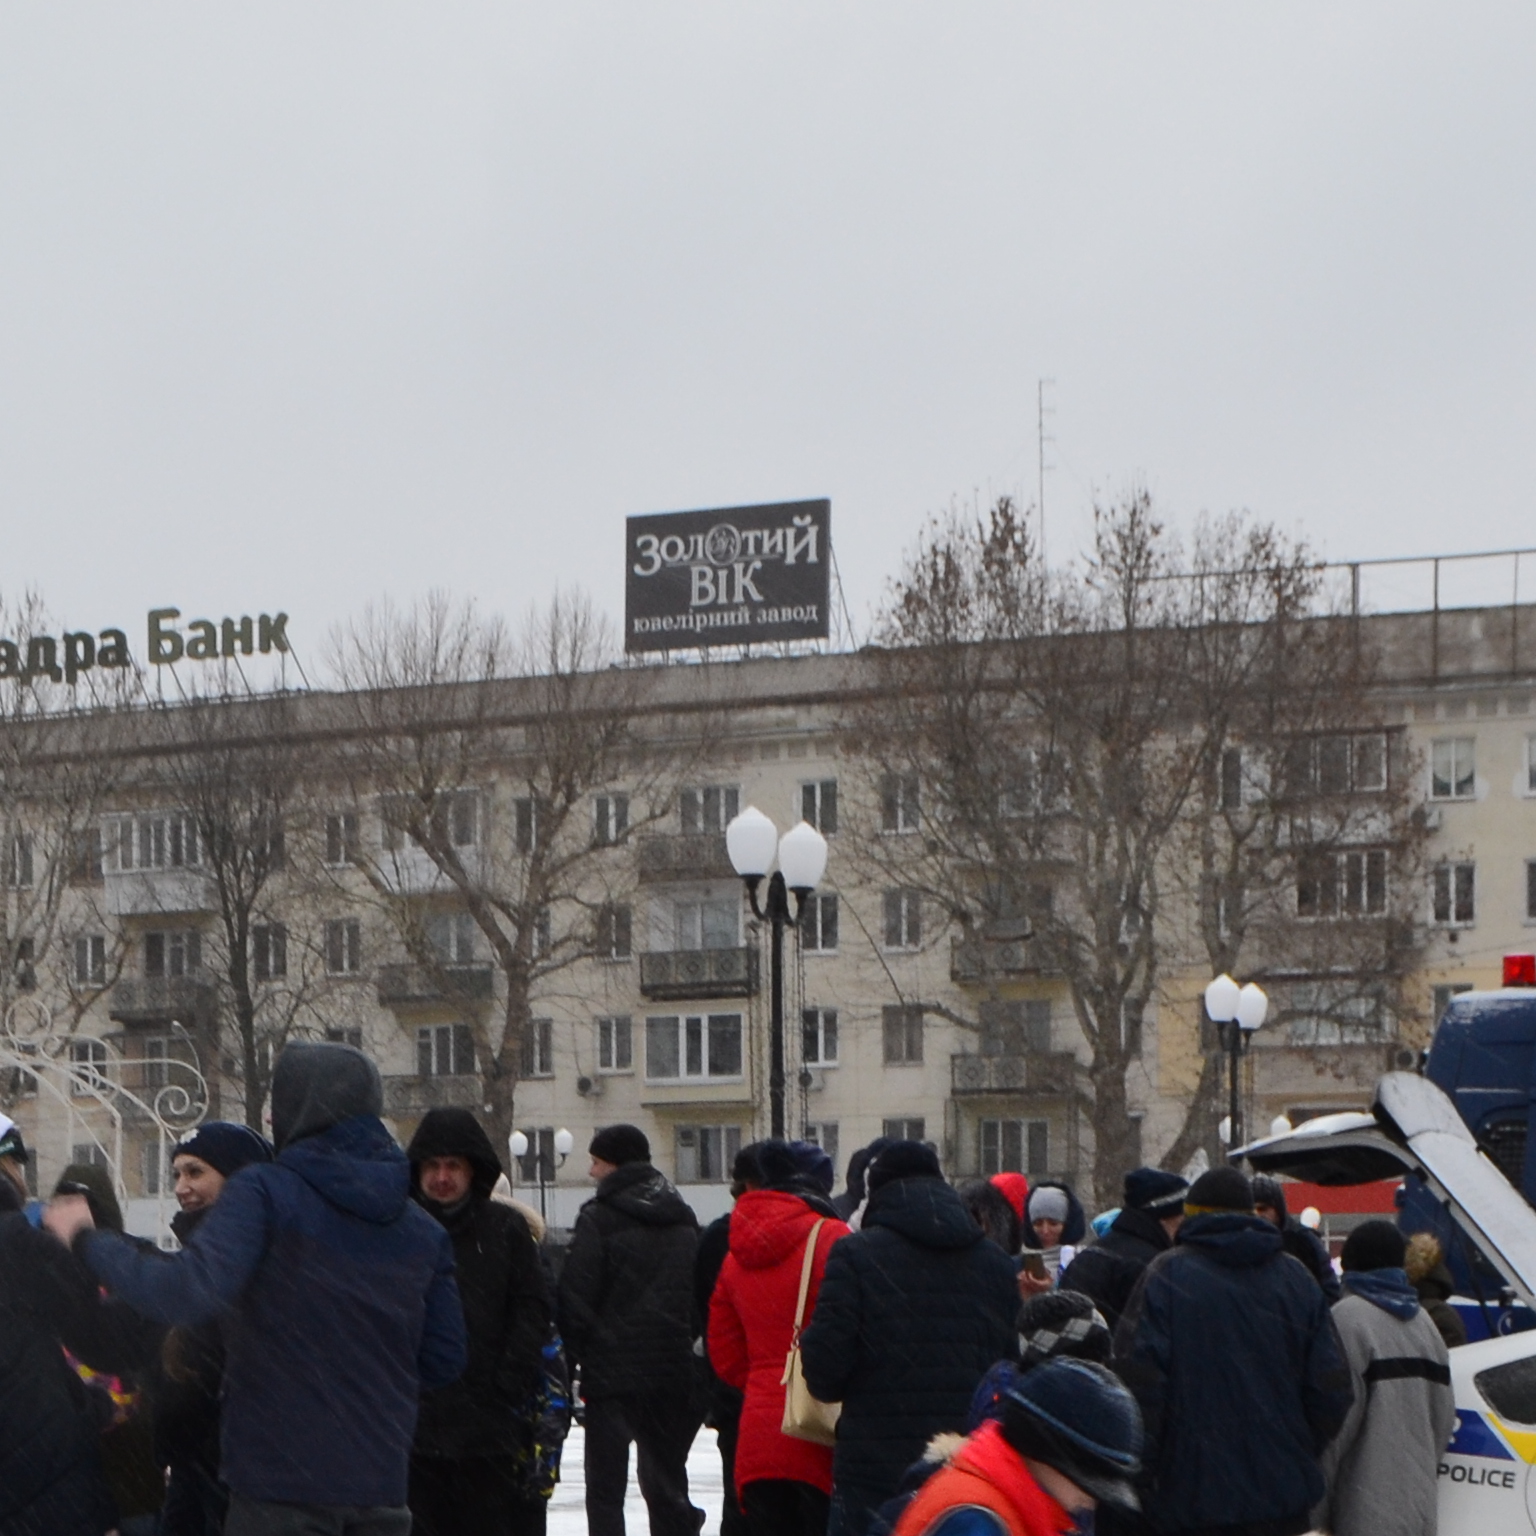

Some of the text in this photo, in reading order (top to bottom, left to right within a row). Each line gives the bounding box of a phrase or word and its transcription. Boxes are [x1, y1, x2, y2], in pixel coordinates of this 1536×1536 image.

[148, 597, 289, 664] Банк
[633, 604, 818, 634] ювелірний завод
[1437, 1463, 1516, 1489] POLICE
